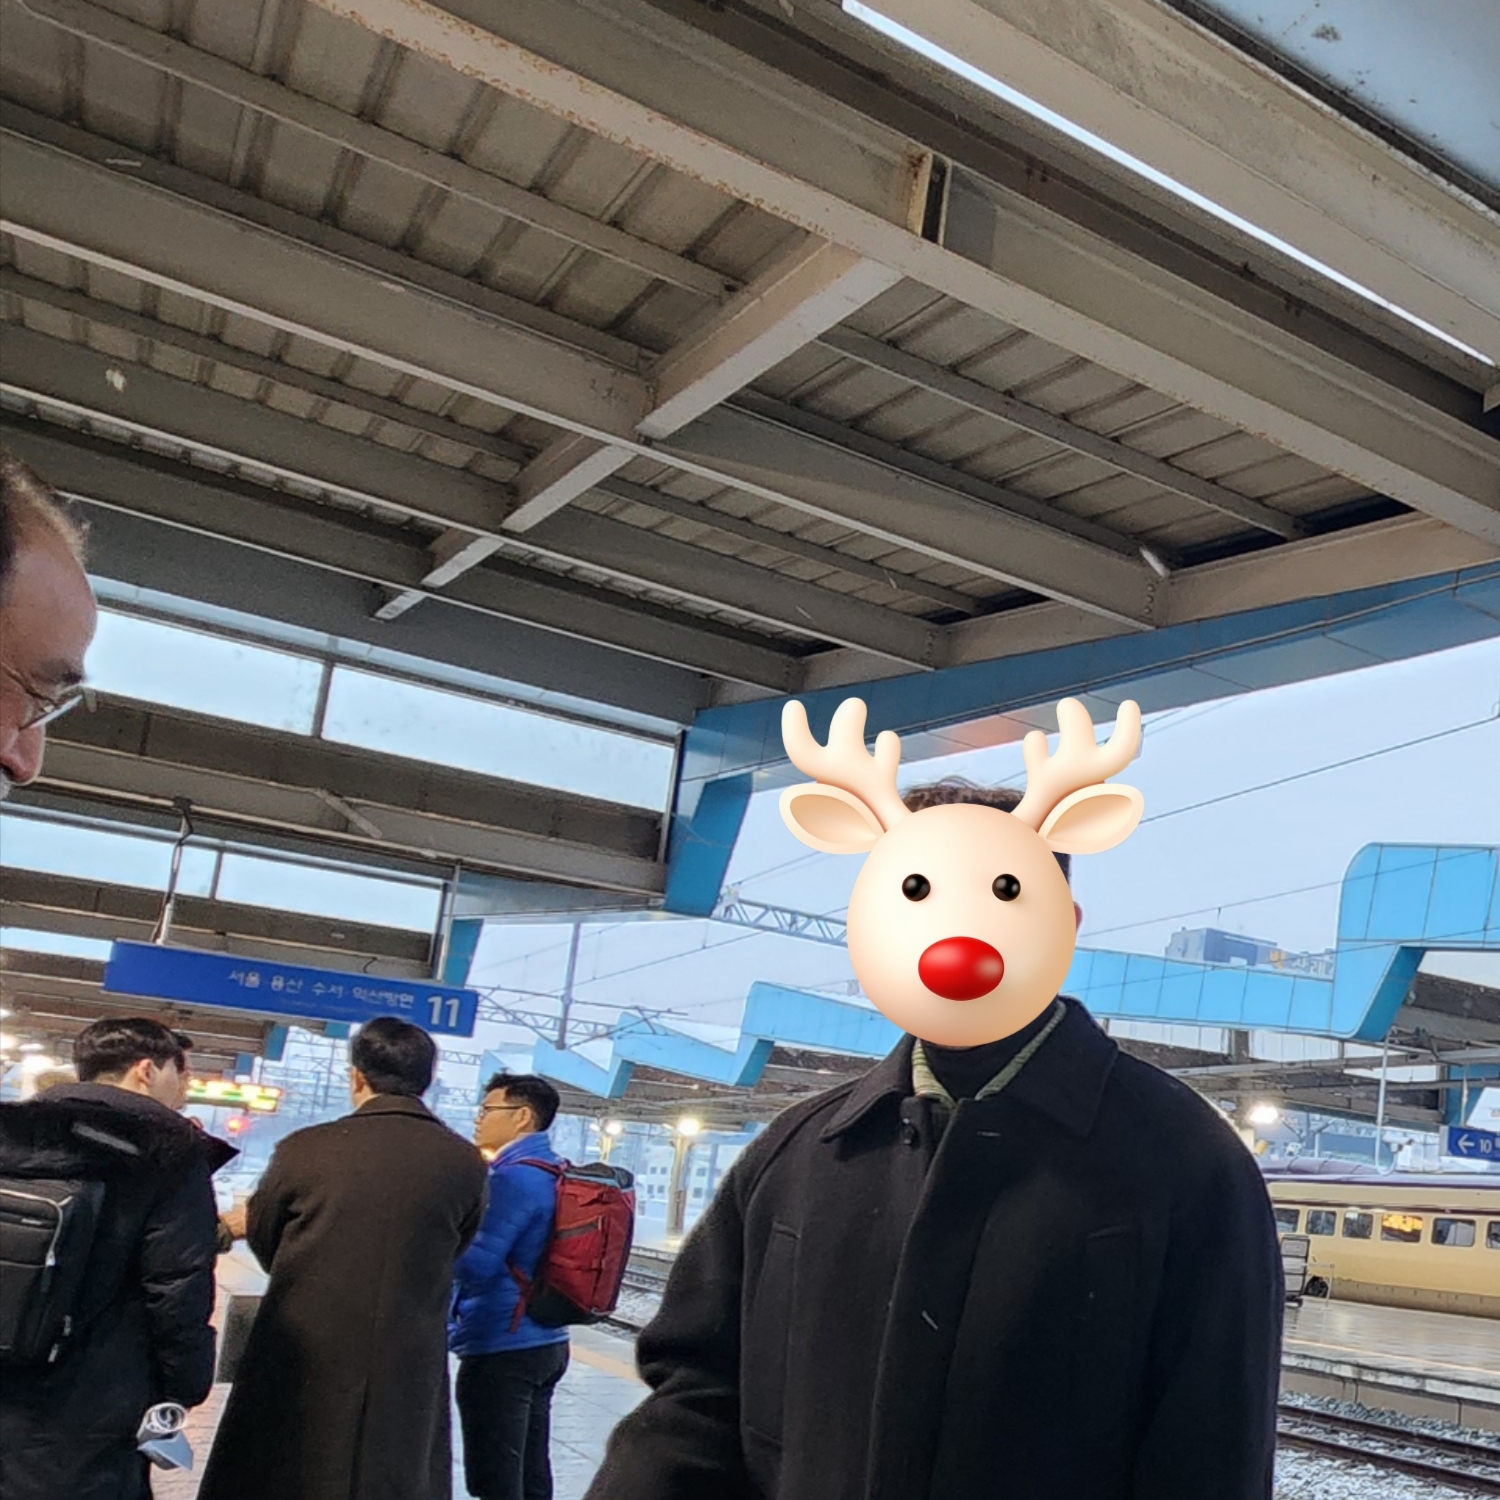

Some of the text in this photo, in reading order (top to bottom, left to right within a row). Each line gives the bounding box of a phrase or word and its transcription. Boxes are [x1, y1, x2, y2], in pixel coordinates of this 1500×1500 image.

[228, 969, 260, 989] 서울
[270, 974, 303, 994] 용산
[311, 981, 344, 999] 수서
[427, 995, 460, 1028] 11
[1479, 1139, 1493, 1154] 10
